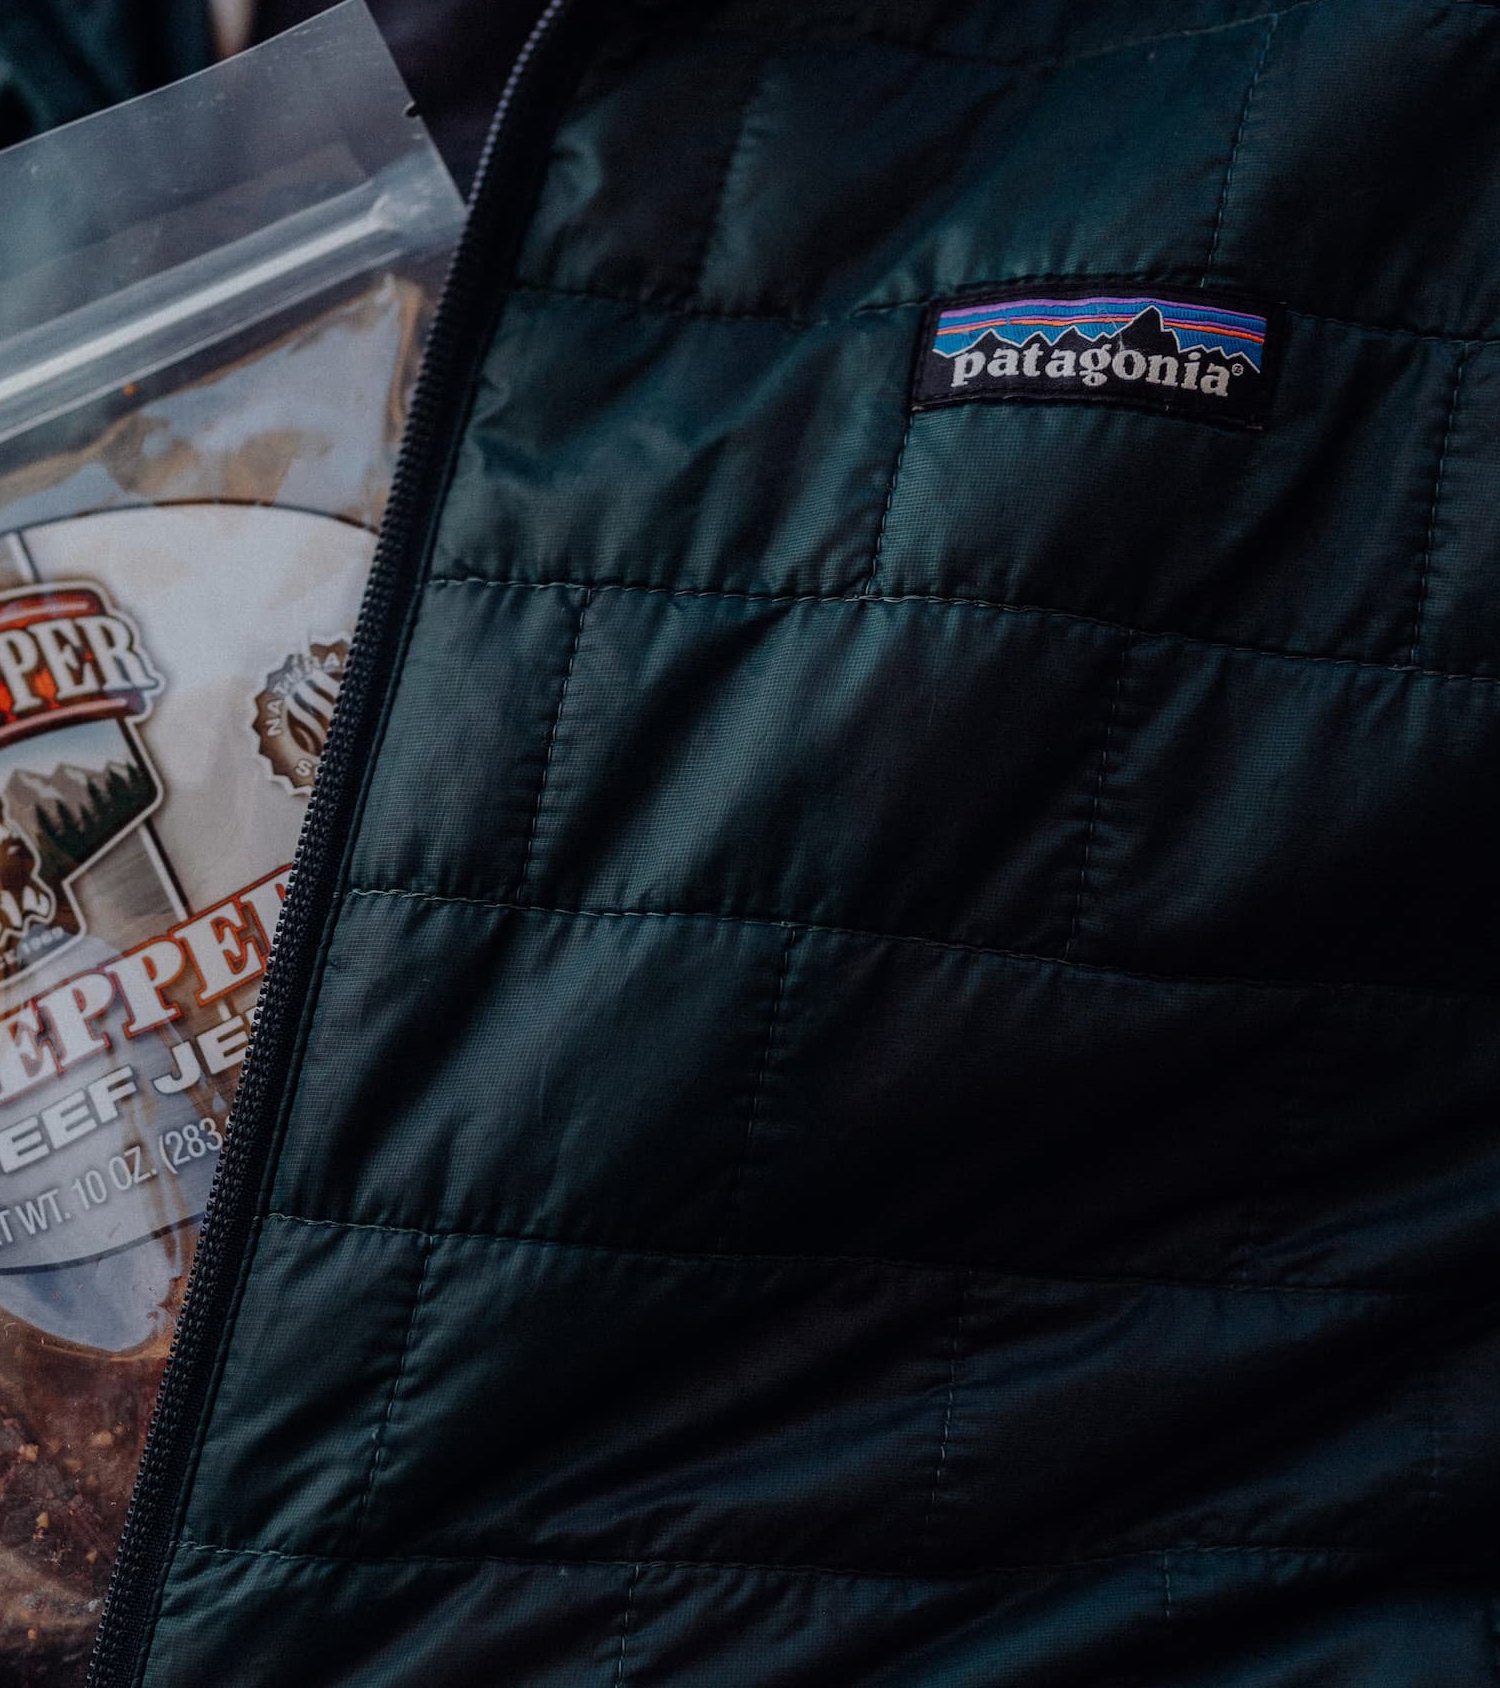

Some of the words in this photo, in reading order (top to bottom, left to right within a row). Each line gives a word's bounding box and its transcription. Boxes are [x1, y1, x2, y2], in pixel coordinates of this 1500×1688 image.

[14, 1188, 71, 1235] WT.
[70, 1169, 108, 1211] 10
[108, 1145, 158, 1191] OZ.
[158, 1116, 223, 1174] (283
